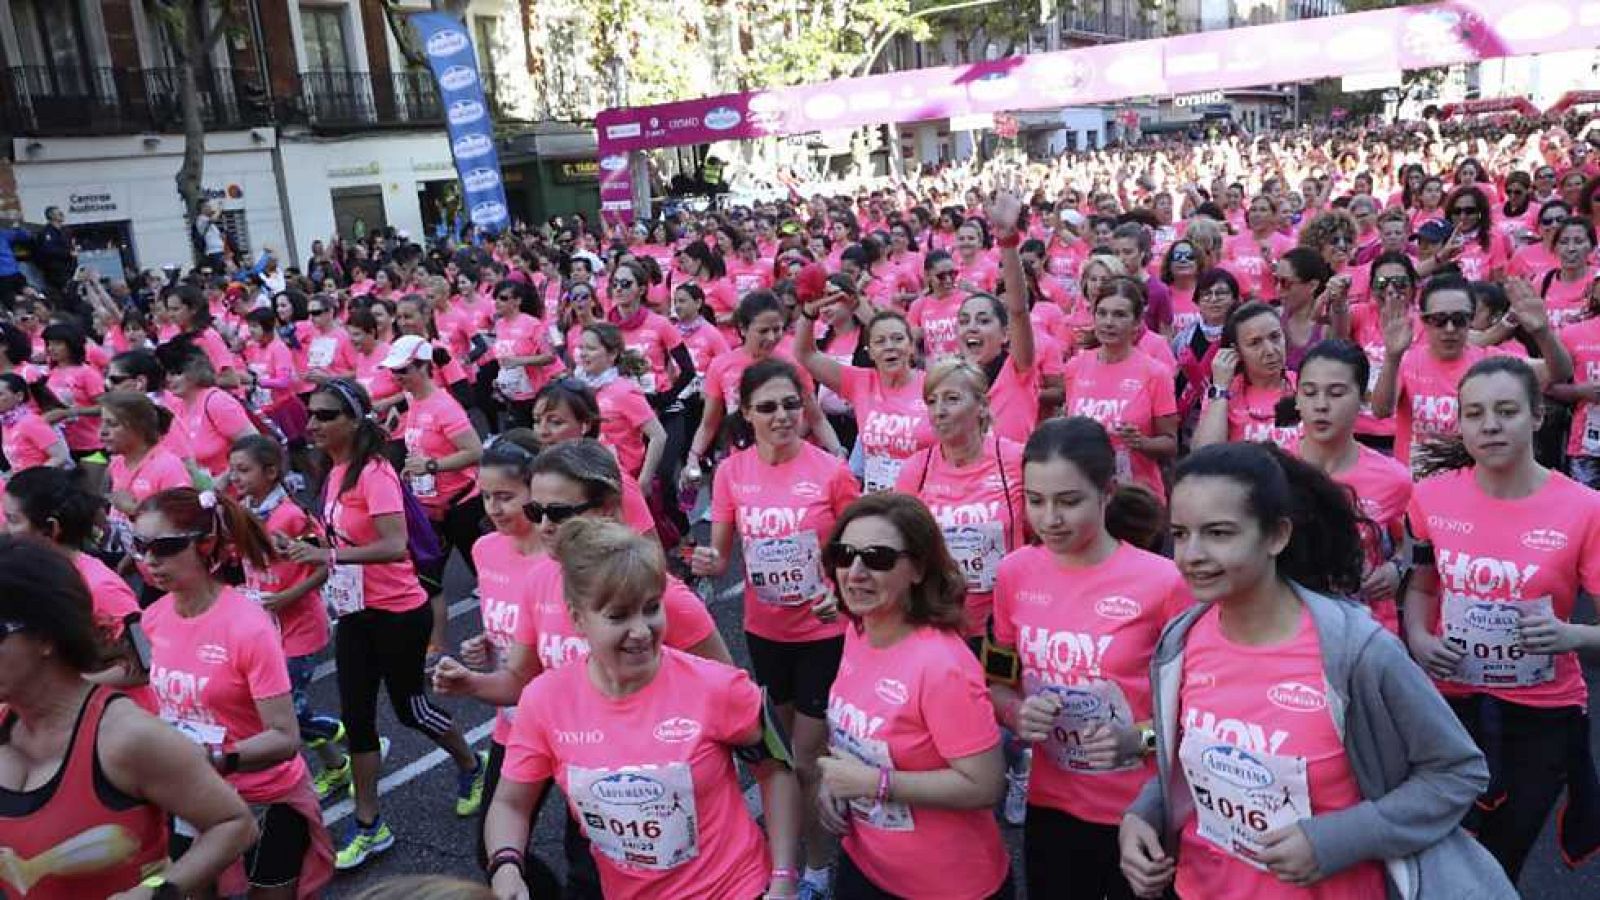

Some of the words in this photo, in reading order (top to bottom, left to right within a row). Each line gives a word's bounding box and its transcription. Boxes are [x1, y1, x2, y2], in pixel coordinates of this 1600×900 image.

[865, 410, 921, 436] HOY
[740, 507, 808, 536] HOY
[768, 568, 804, 586] 016
[963, 557, 984, 572] 16
[1437, 548, 1541, 599] HOY
[538, 632, 591, 668] HO
[1020, 625, 1114, 676] HOY
[1473, 642, 1525, 661] 016
[1054, 726, 1081, 746] 01
[1185, 708, 1289, 755] HOY
[609, 816, 662, 839] 016
[1217, 796, 1269, 832] 016
